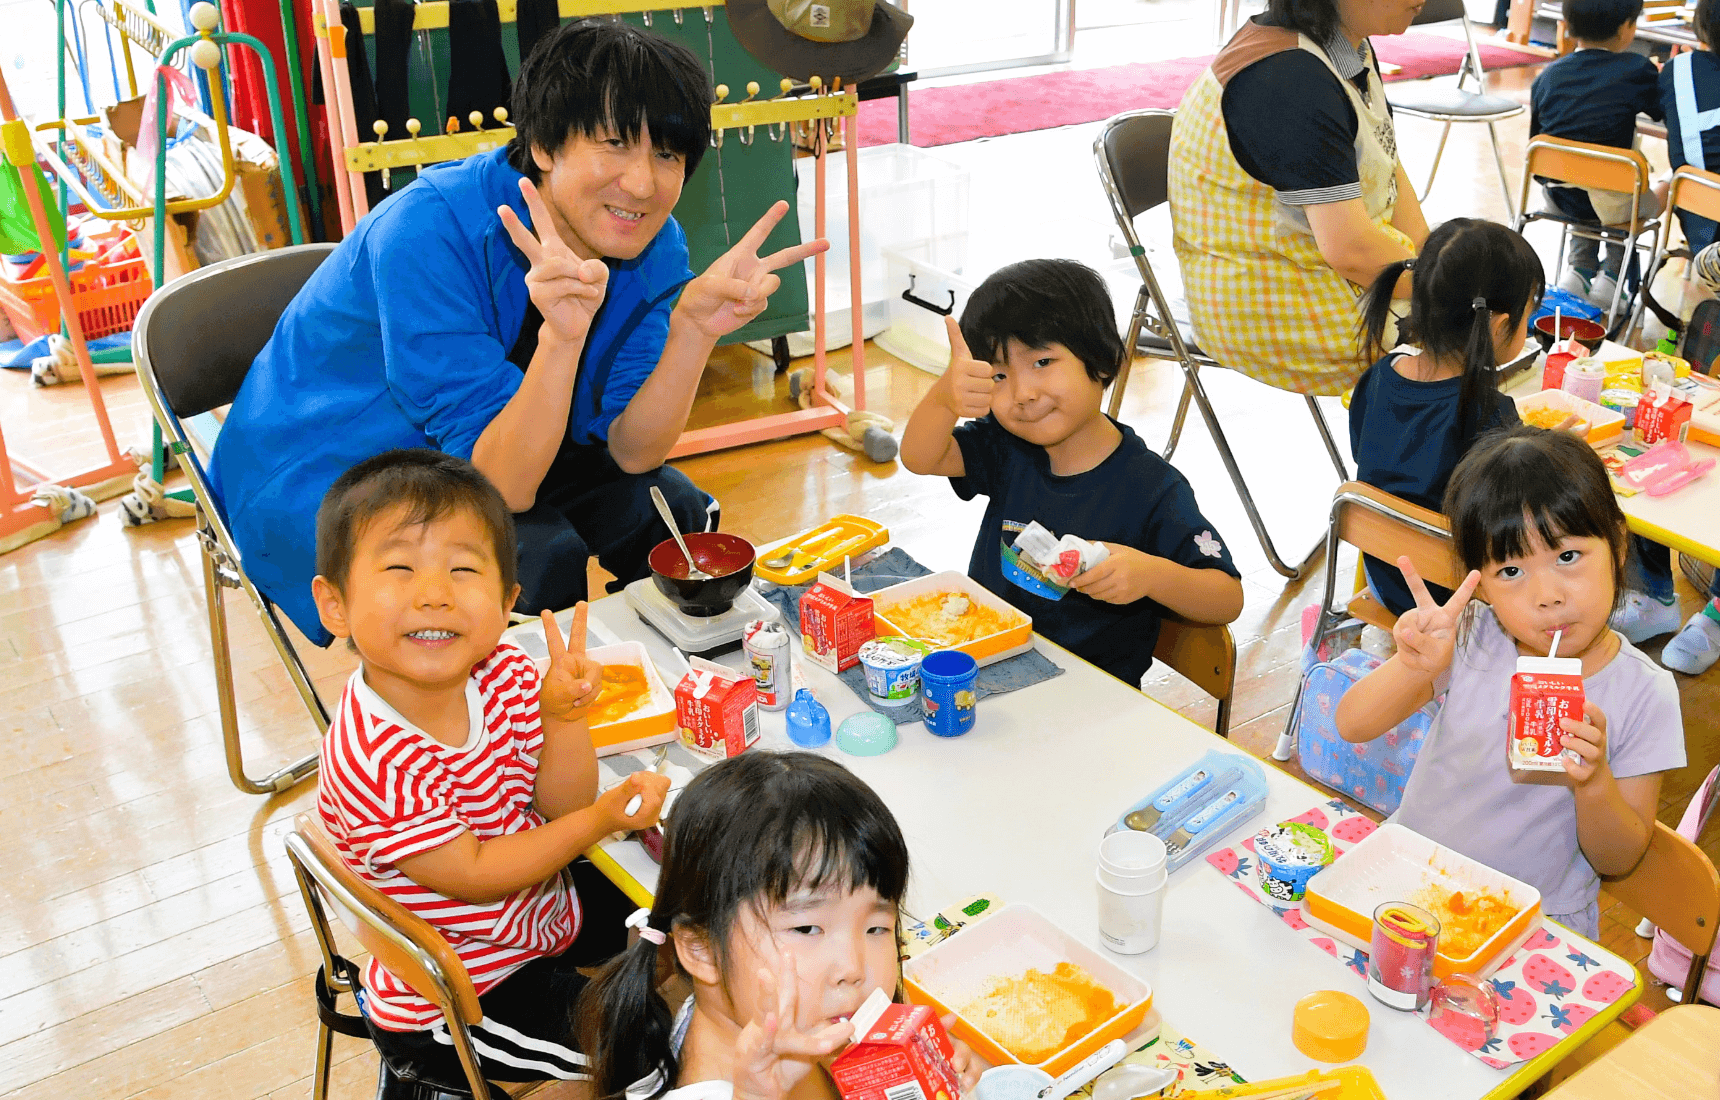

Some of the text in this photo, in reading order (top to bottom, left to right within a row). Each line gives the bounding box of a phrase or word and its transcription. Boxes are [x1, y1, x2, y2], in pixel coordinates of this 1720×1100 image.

[703, 704, 713, 734] おいしい
[1544, 697, 1558, 755] 雪印メグミルク
[1556, 699, 1570, 736] おいい
